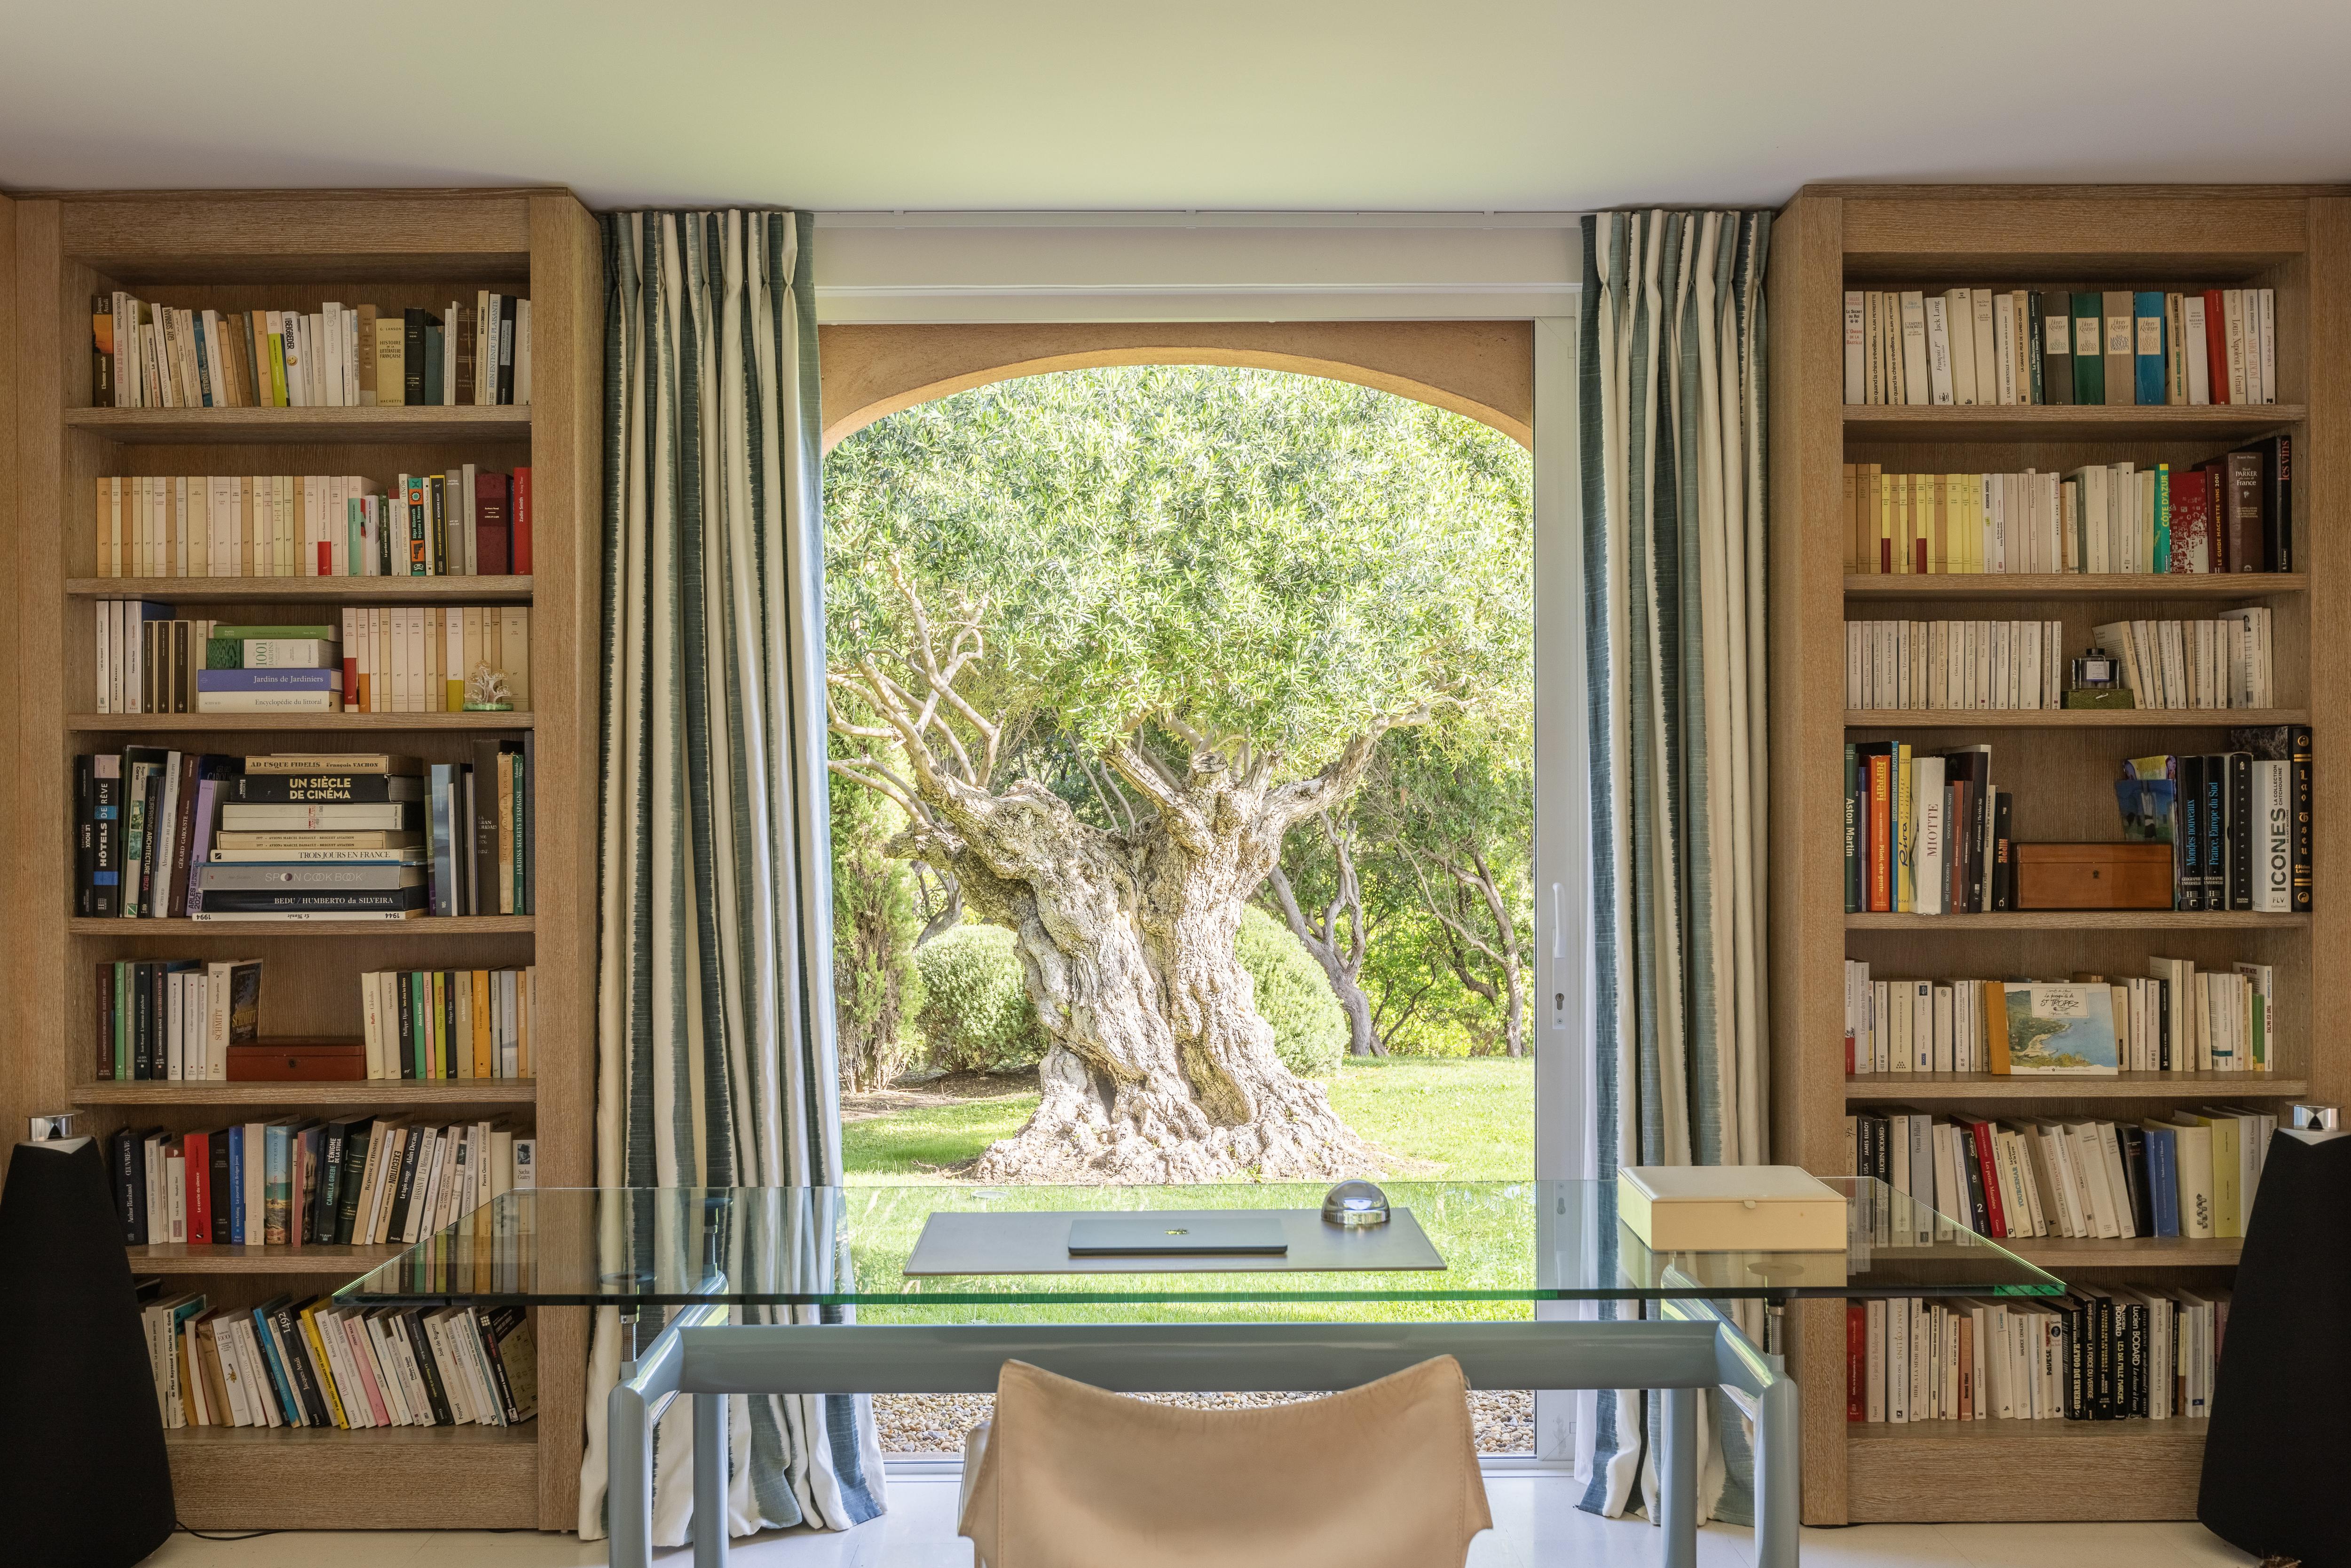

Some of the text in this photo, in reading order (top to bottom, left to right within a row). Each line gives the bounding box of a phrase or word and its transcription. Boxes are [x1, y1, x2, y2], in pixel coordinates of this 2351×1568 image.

[165, 308, 173, 329] SORMAN
[2231, 339, 2240, 365] Napoléon
[2279, 465, 2289, 481] les
[255, 642, 267, 666] 1001
[290, 775, 350, 788] UN SIÈCLE
[1877, 761, 1886, 801] Ferrari
[290, 788, 350, 799] DE CINÉMA
[101, 806, 107, 818] DE
[2209, 782, 2218, 865] France, Europe du Sud
[1927, 804, 1938, 857] MIOTTE
[1899, 822, 1908, 867] Riva
[1998, 839, 2008, 863] HIPPIE
[2187, 837, 2195, 866] Mondes
[2271, 808, 2286, 891] ICONES
[304, 873, 332, 881] COOK
[335, 873, 363, 881] BOOK
[2051, 999, 2079, 1008] TROPEZ
[2012, 1167, 2024, 1208] YOURCENAR
[279, 1312, 291, 1333] 1492
[294, 1357, 309, 1390] Jacques Attali
[2074, 1367, 2081, 1379] DU
